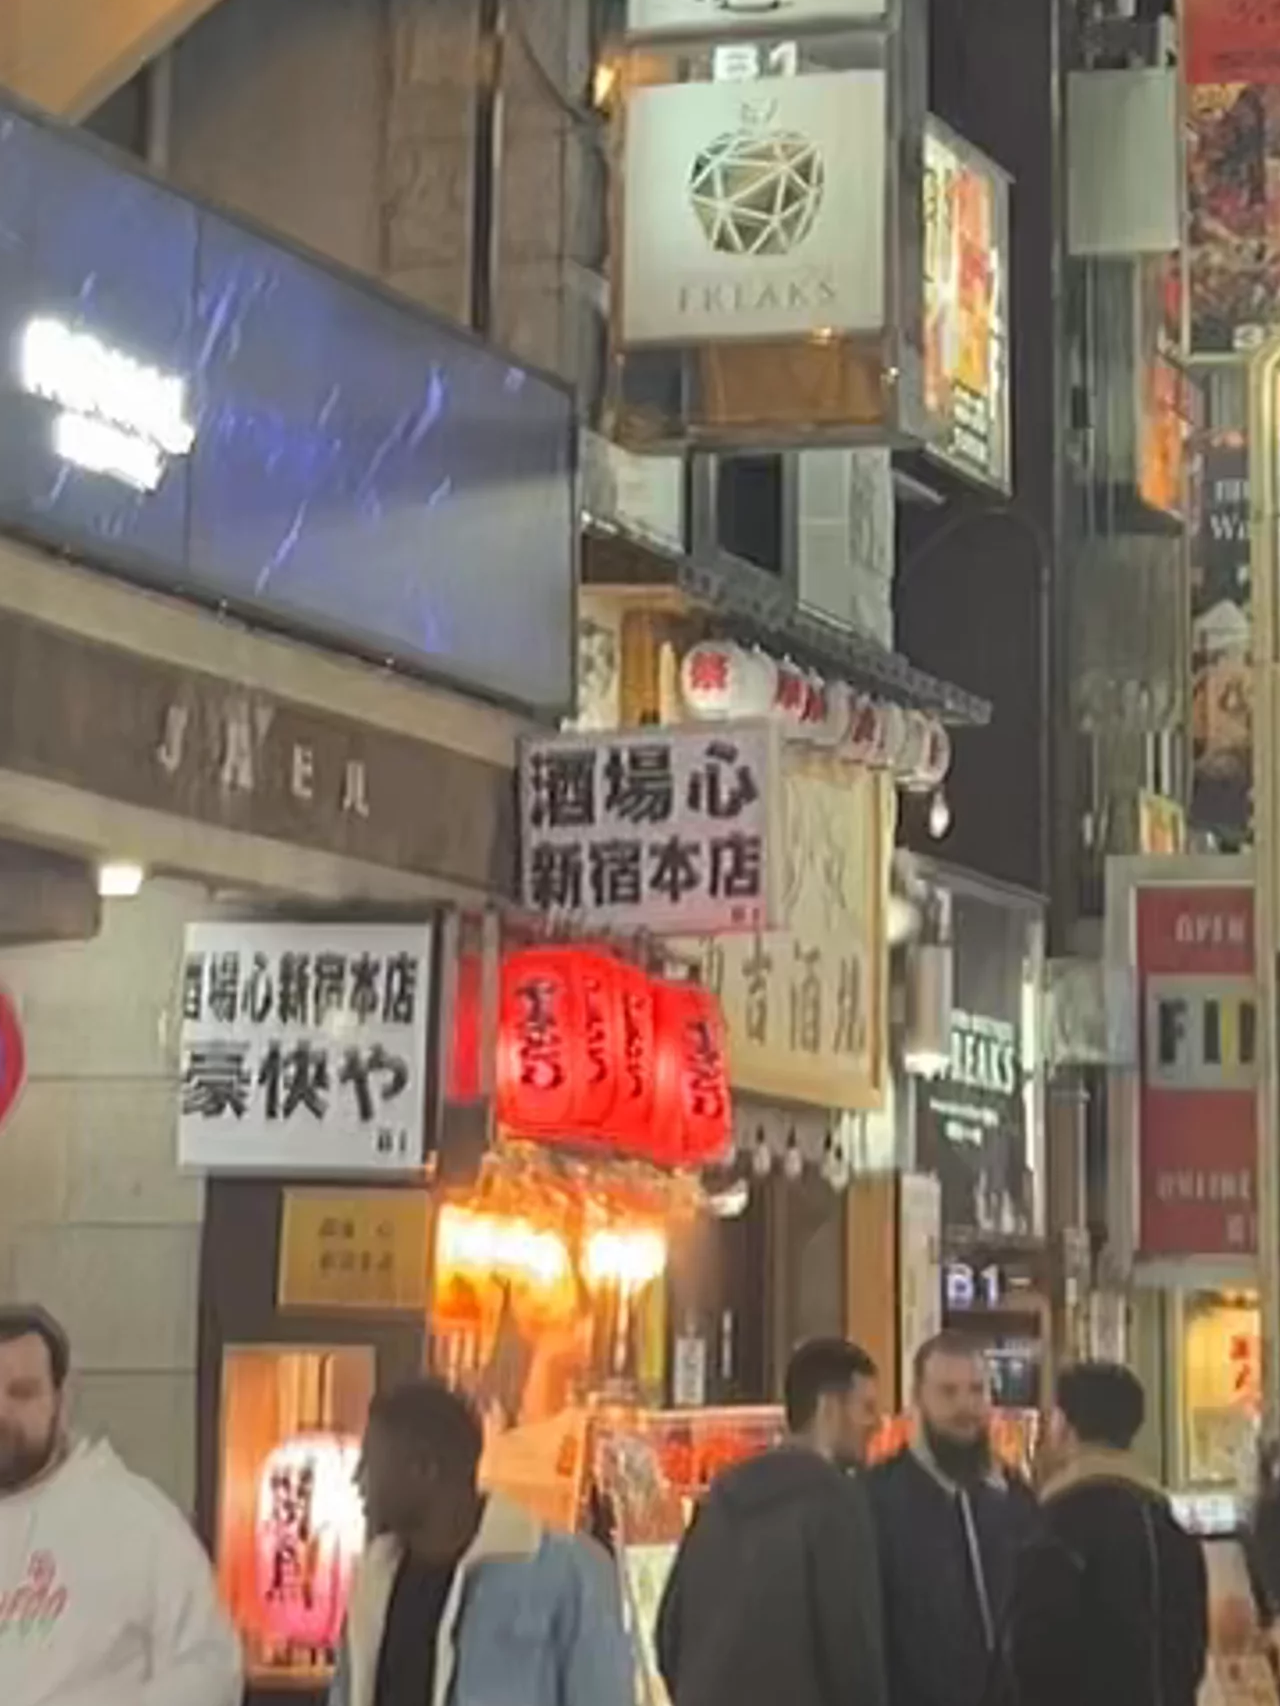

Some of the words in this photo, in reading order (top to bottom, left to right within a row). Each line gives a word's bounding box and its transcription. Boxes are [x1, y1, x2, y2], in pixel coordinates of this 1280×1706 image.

[529, 740, 760, 829] 酒場心
[531, 833, 763, 910] 新宿本店
[181, 1040, 413, 1125] 豪快や
